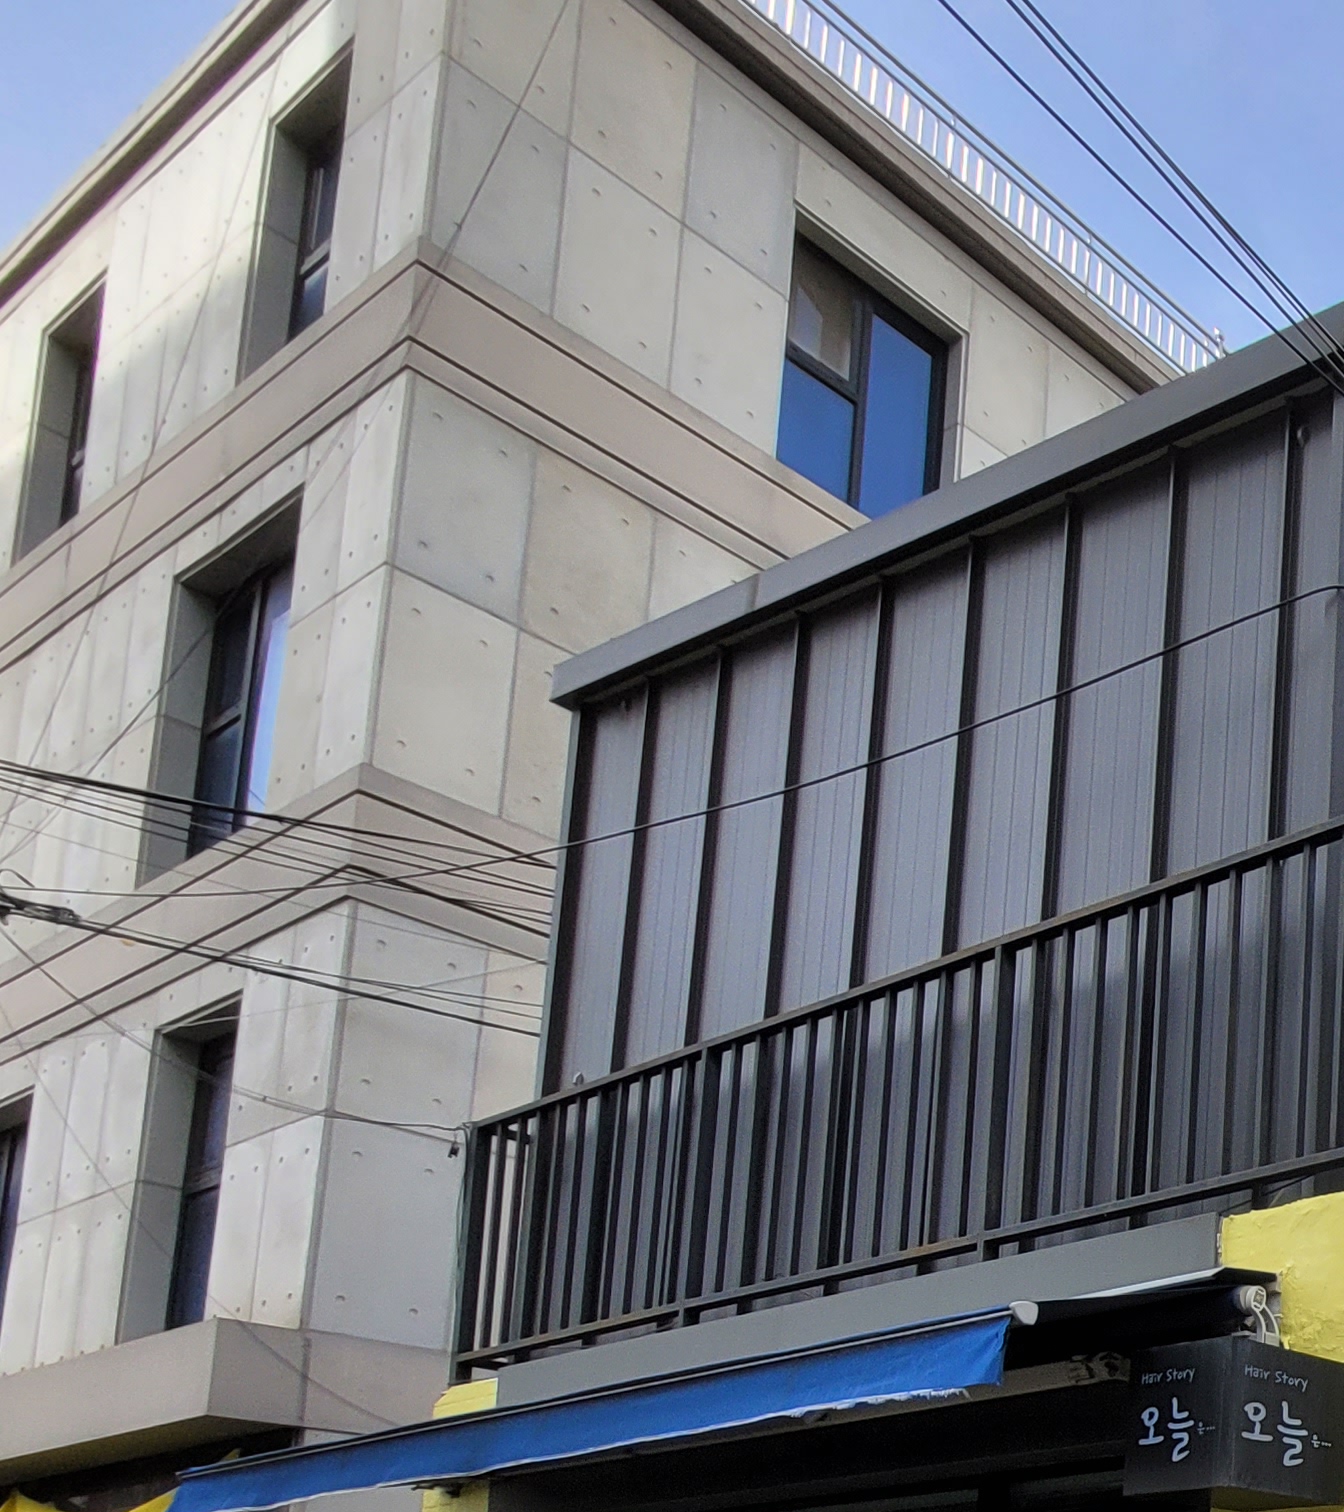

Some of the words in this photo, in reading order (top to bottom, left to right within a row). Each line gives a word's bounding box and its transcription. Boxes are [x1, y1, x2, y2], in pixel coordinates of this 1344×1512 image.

[1142, 1370, 1163, 1385] Hair
[1166, 1367, 1195, 1383] Story
[1244, 1364, 1270, 1380] Hair
[1275, 1370, 1309, 1392] Story
